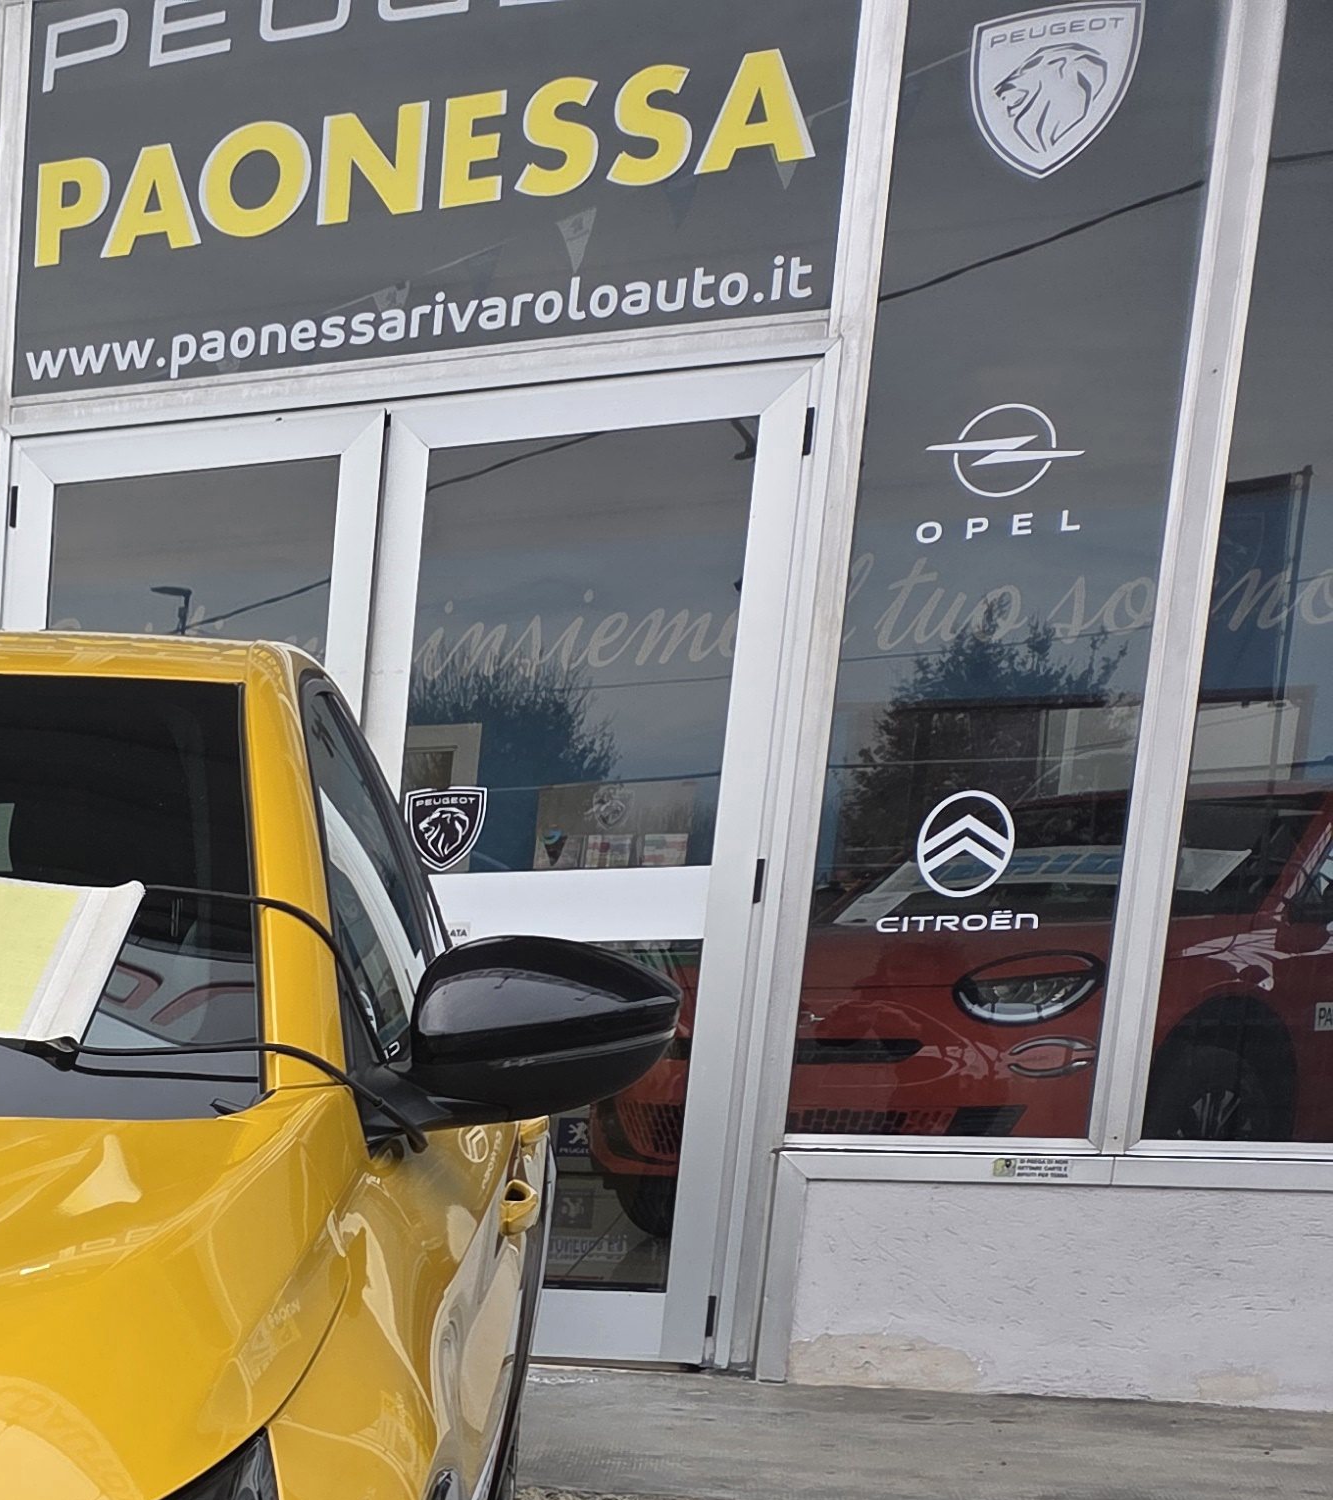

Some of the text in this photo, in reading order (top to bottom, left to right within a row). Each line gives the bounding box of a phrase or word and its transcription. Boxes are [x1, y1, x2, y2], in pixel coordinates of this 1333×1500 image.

[990, 17, 1124, 48] PEUGEOT
[34, 48, 815, 268] PAONESSA
[25, 256, 813, 380] www.paonessarivaroloauto.it
[915, 509, 1082, 544] OPEL
[876, 556, 1028, 652] tuo
[415, 796, 476, 808] PEUGEOT
[876, 910, 1040, 934] CITROËN
